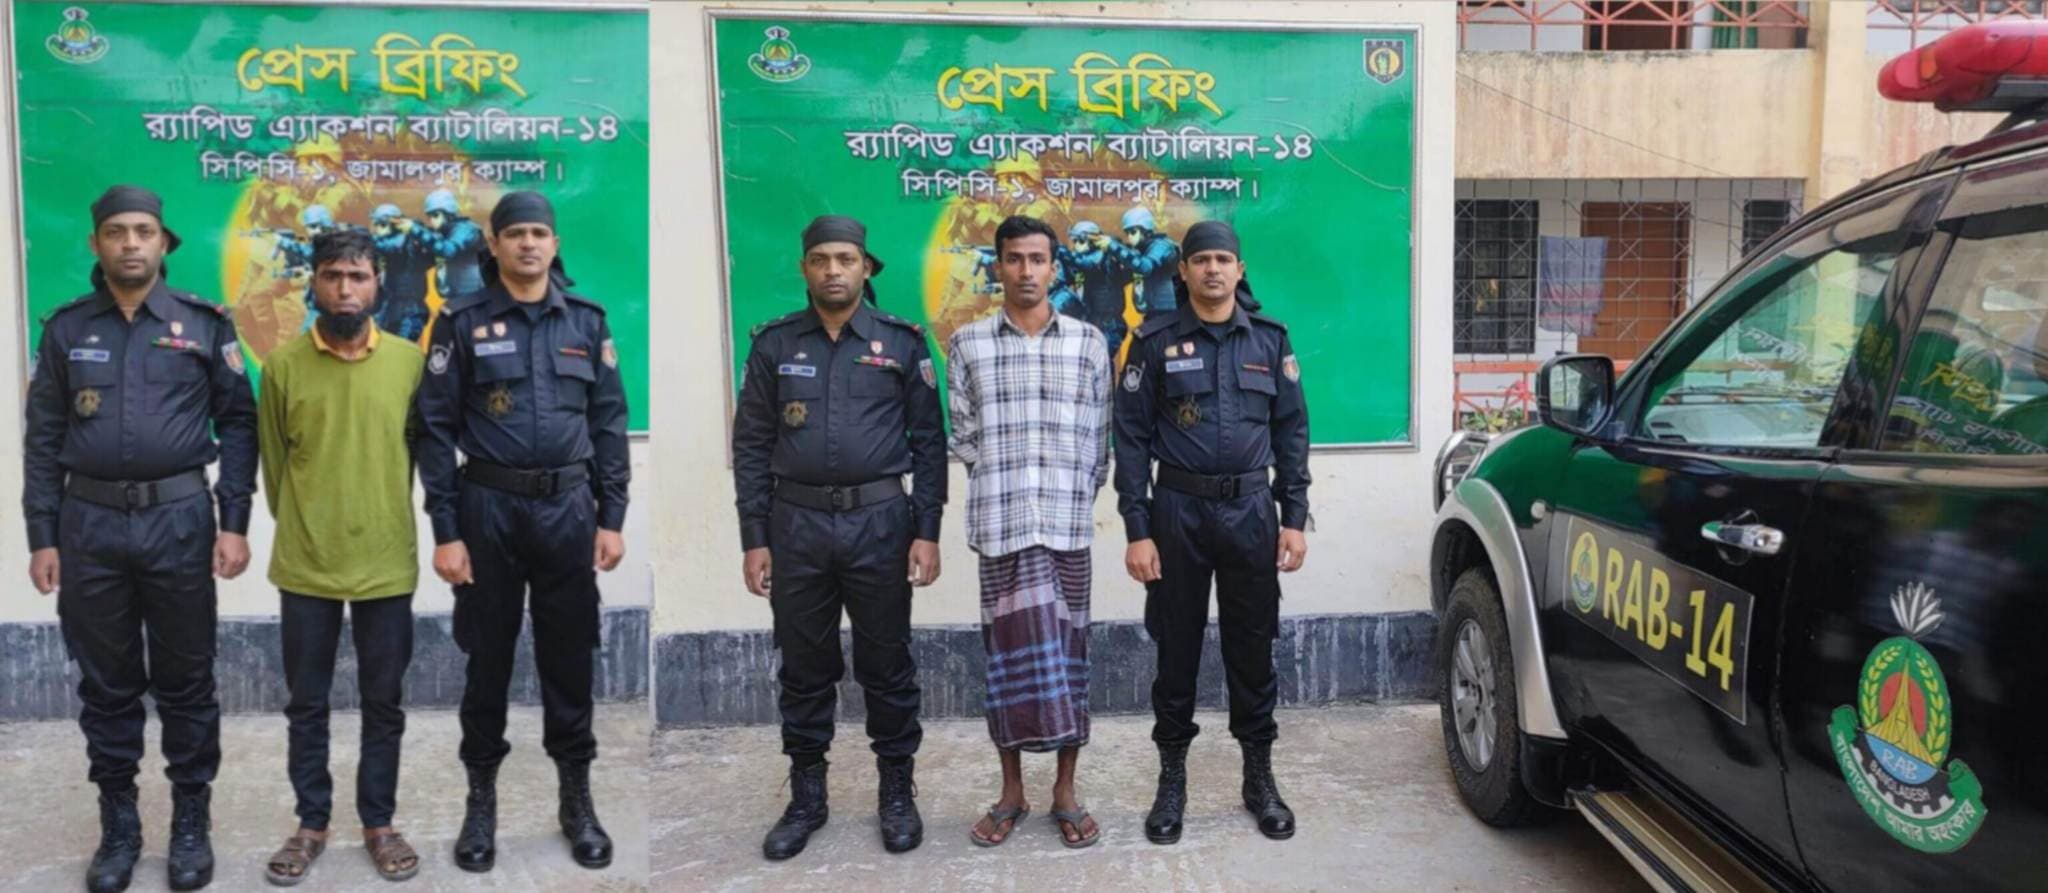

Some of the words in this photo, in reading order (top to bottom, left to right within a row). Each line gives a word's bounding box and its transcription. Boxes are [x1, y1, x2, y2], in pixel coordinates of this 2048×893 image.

[236, 42, 357, 95] প্রেস
[370, 32, 528, 100] ব্রিফিং
[936, 61, 1056, 113] প্রেস
[1068, 51, 1225, 119] ব্রিফিং
[267, 111, 399, 143] এ্যাকশন
[407, 106, 620, 143] ব্যাটালিয়ন-১৪
[969, 130, 1097, 161] এ্যাকশন
[1104, 124, 1314, 161] ব্যাটালিয়ন-১৪
[346, 158, 465, 186] জামালপুর
[1045, 176, 1162, 203] জামালপুর
[1603, 547, 1736, 692] RAB-14
[1881, 749, 1919, 781] RAB
